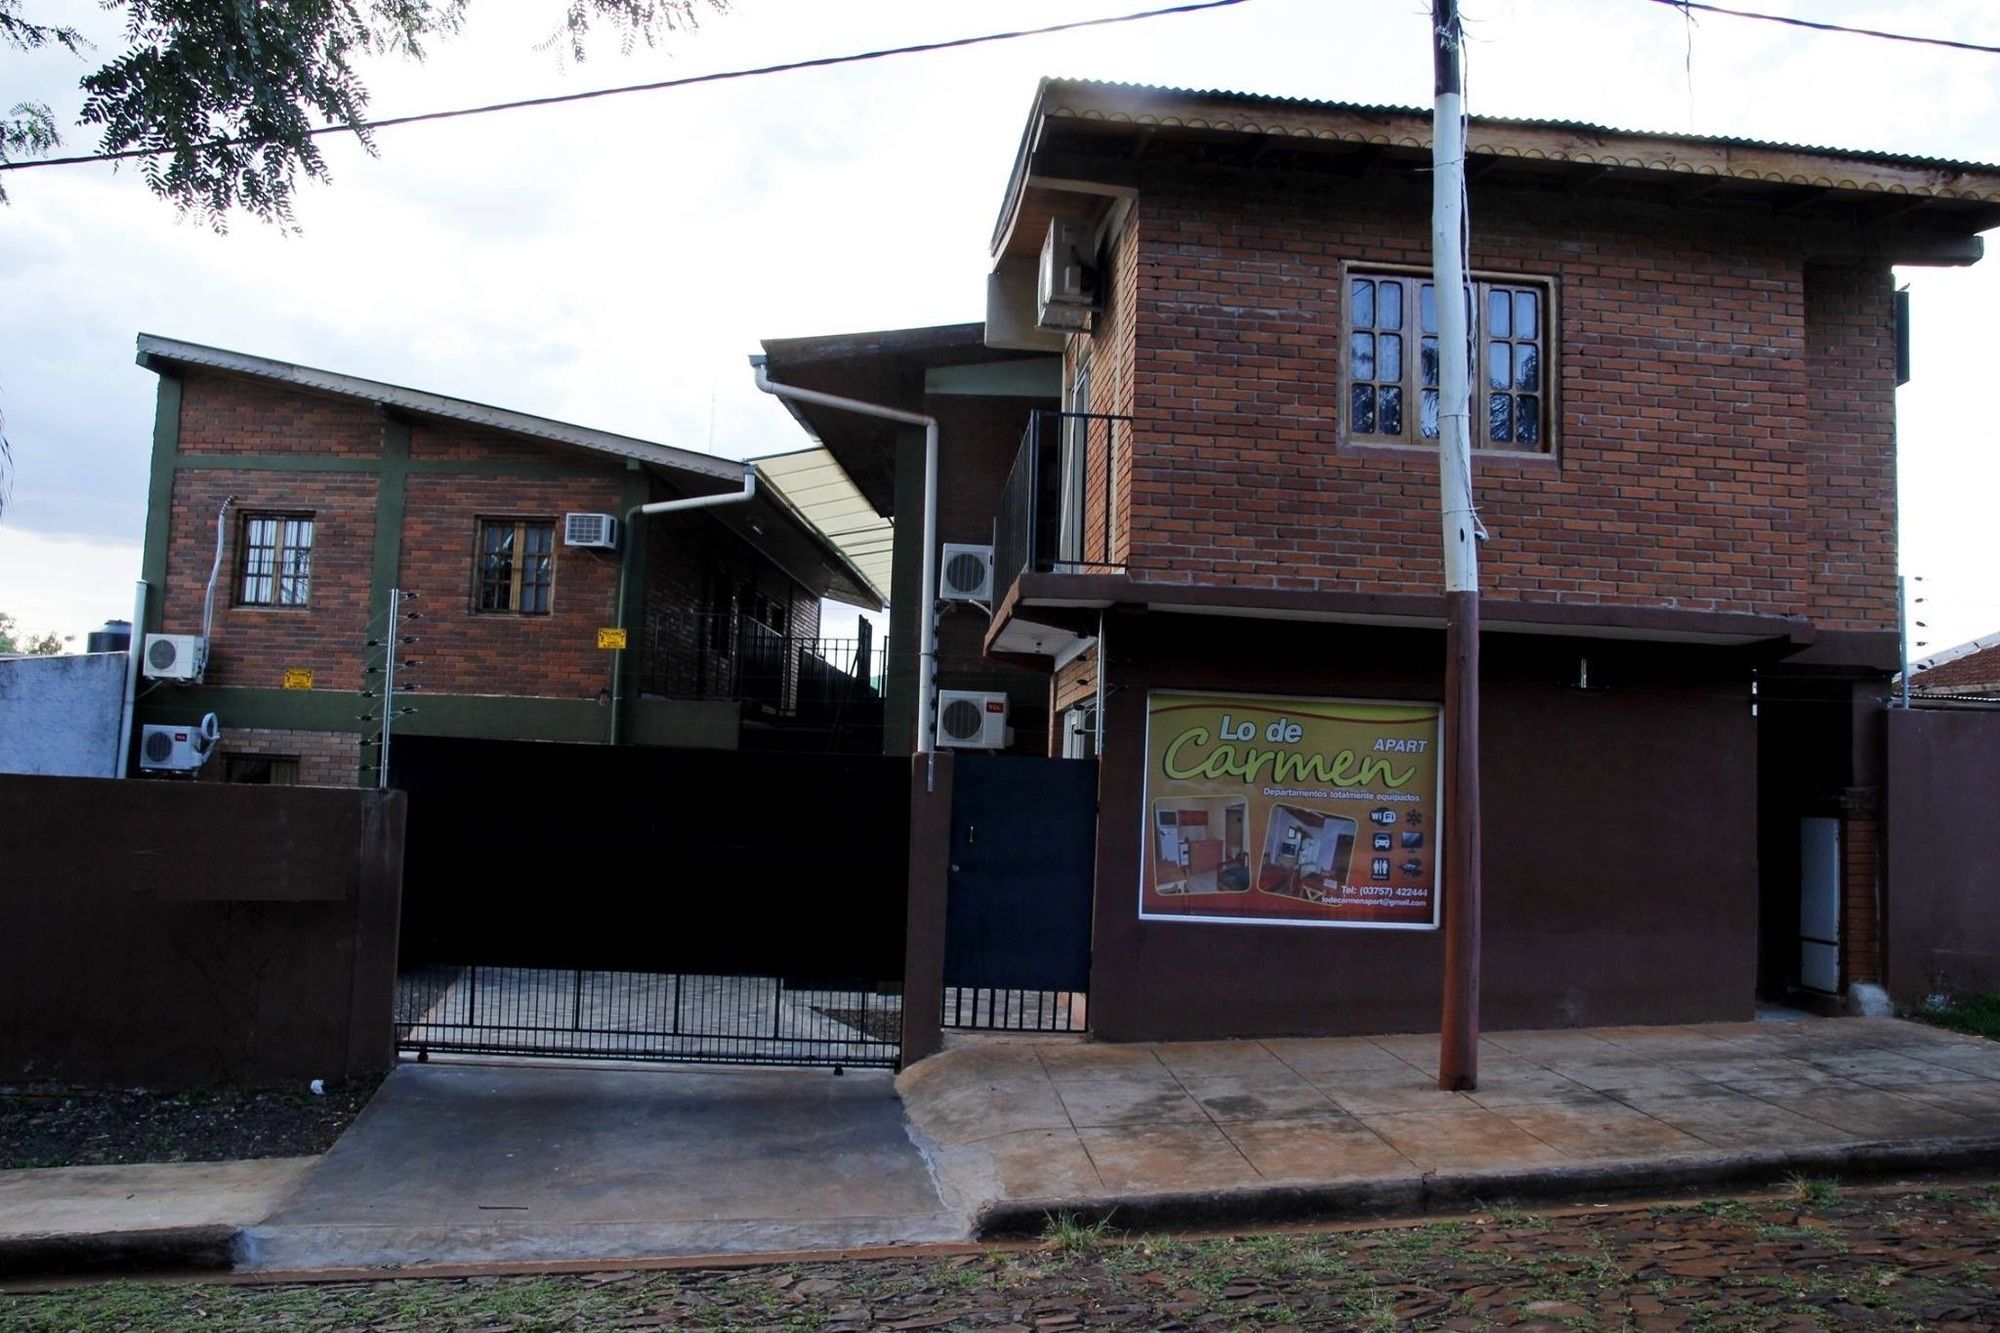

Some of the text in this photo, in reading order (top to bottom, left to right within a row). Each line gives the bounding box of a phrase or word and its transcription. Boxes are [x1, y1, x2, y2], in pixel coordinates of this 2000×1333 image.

[1219, 714, 1303, 743] Lo de
[1373, 737, 1428, 753] APART
[1163, 727, 1416, 787] Carmen
[1263, 787, 1420, 803] Departamentos totalmente equipados
[1341, 886, 1428, 897] Tel: (03757) 422444
